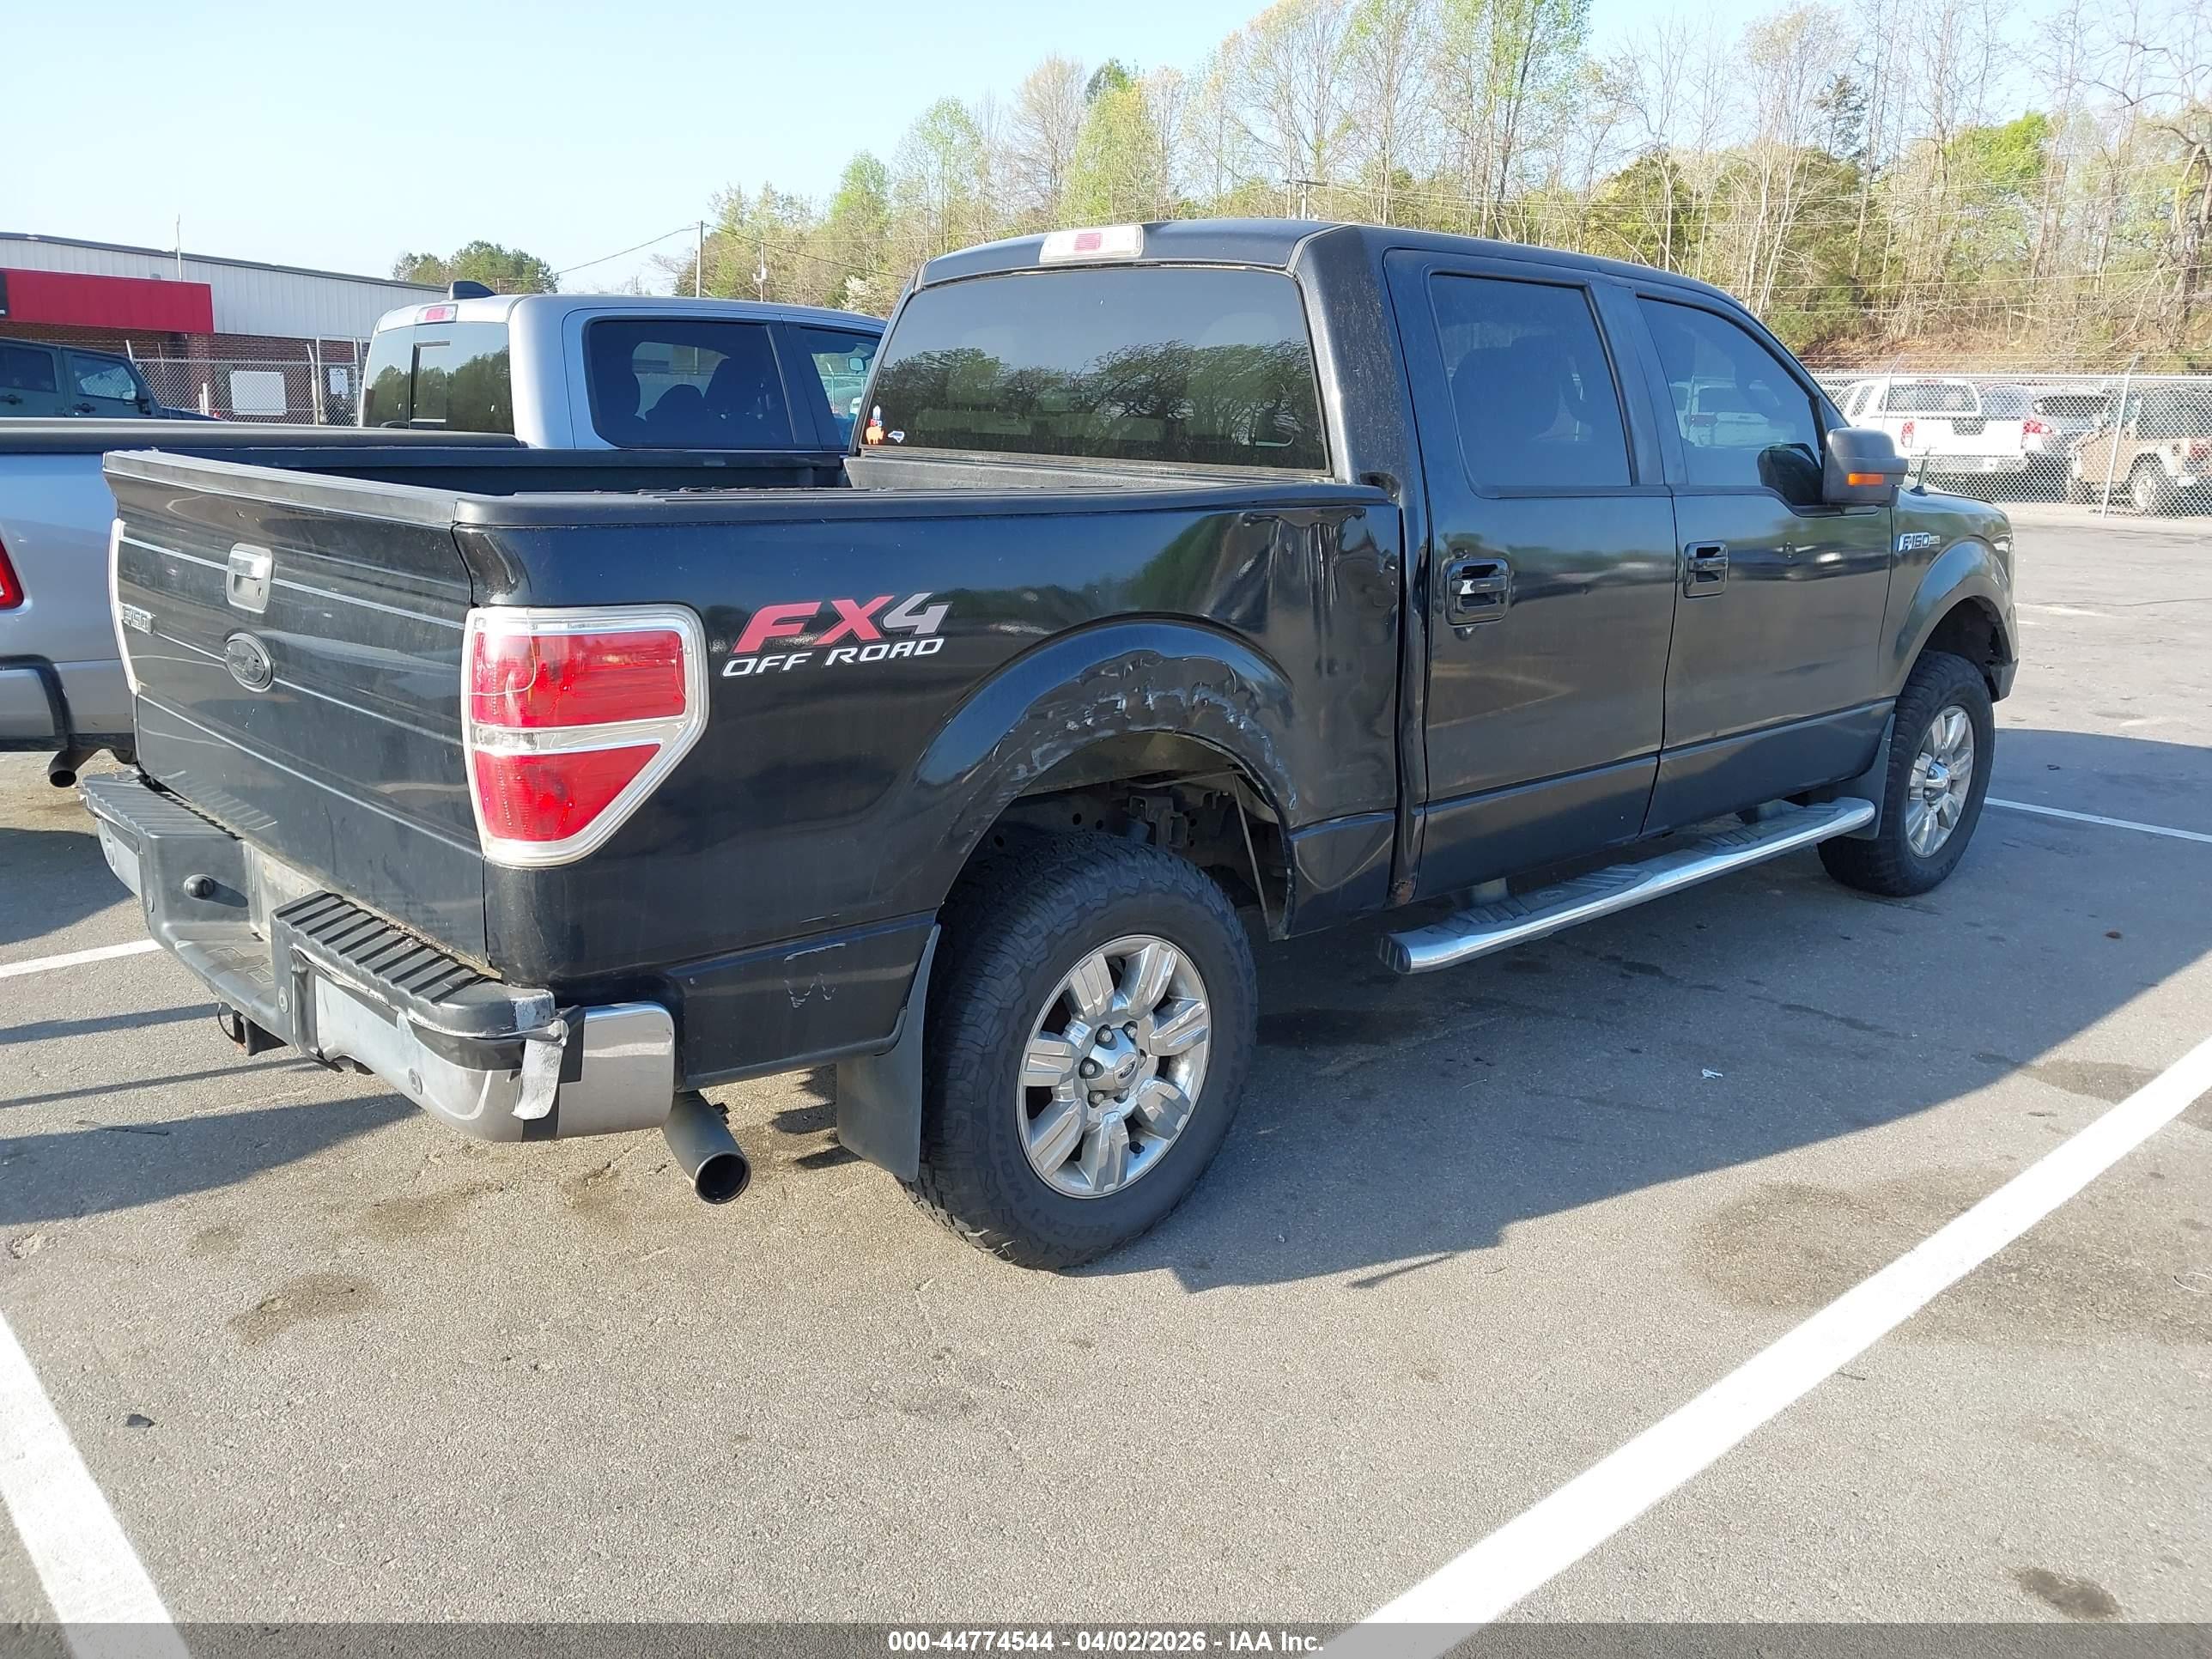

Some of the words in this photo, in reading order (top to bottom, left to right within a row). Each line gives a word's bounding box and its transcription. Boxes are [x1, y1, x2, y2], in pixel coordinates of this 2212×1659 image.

[732, 591, 951, 654] FX4
[721, 652, 812, 678] OFF
[824, 638, 945, 666] ROAD
